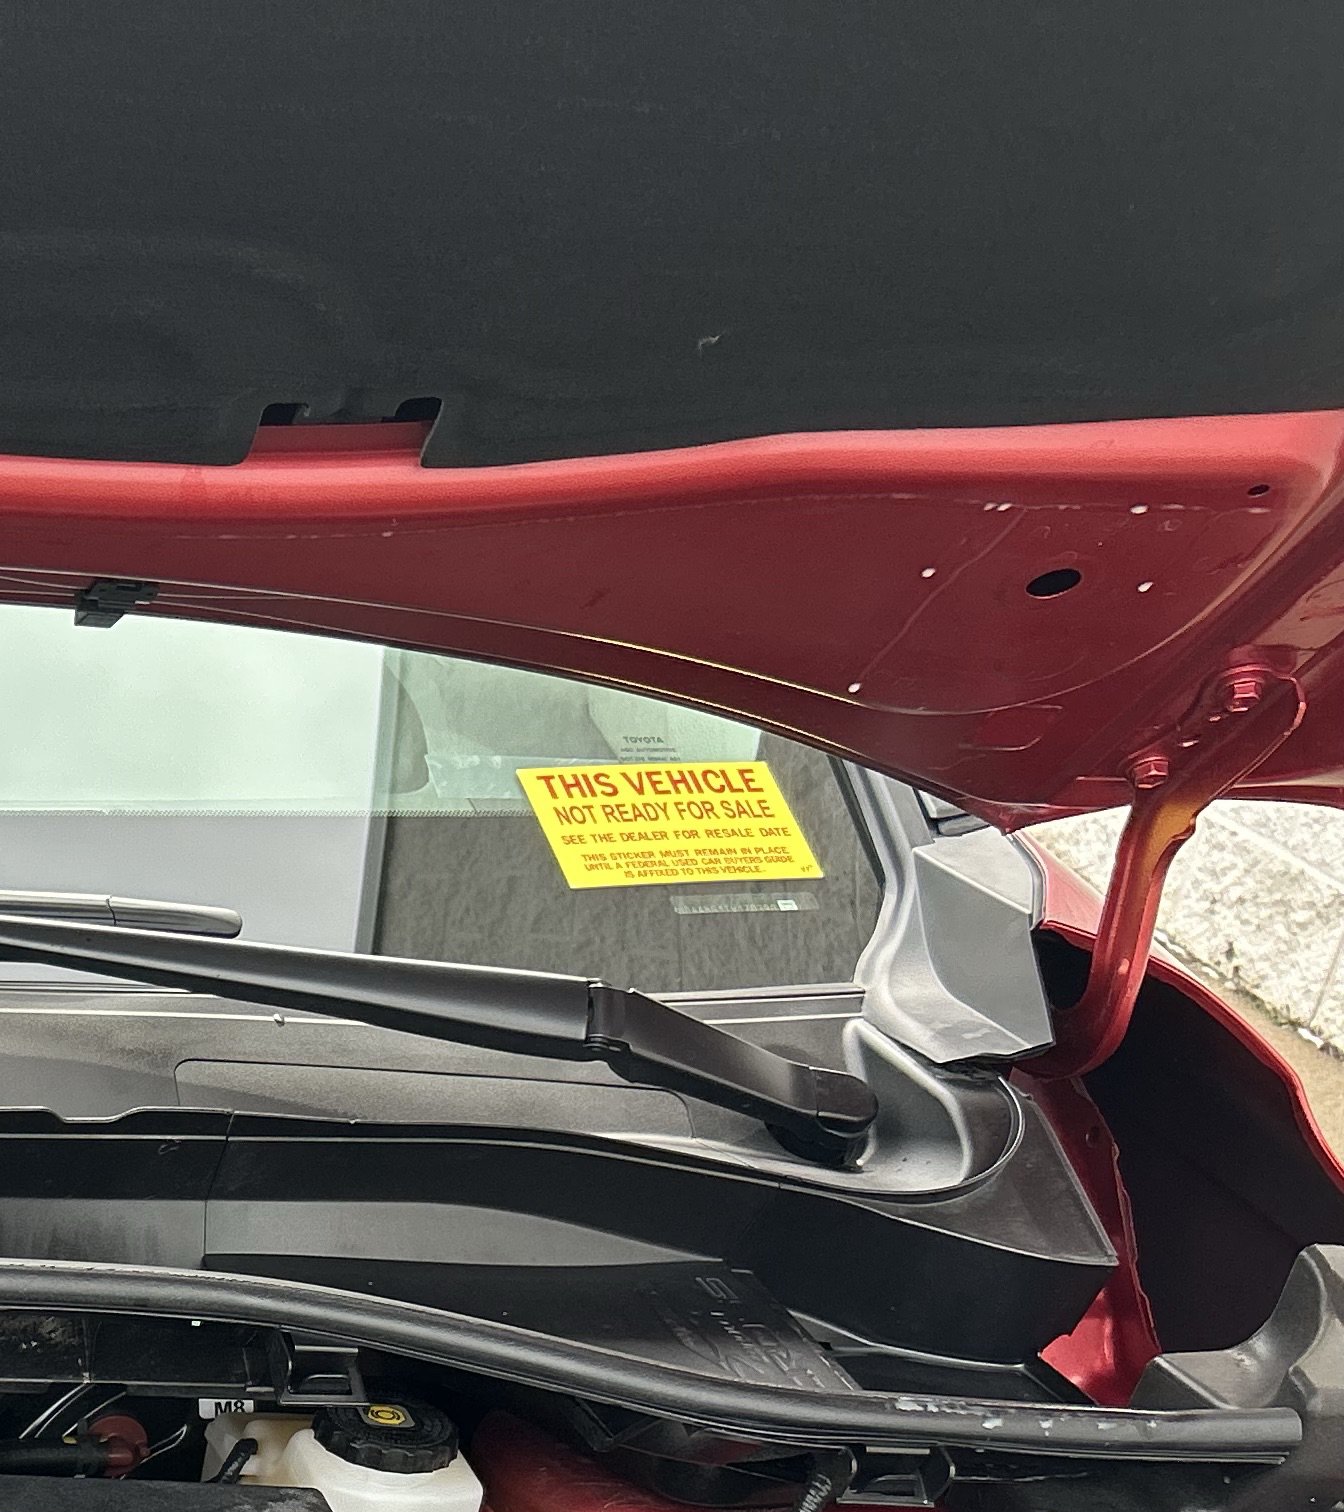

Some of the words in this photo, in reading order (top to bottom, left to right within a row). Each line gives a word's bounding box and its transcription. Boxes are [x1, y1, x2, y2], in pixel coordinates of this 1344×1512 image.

[536, 772, 619, 799] THIS
[619, 769, 764, 795] VEHICLE
[553, 805, 598, 825] NOT
[600, 802, 670, 823] READY
[673, 801, 720, 820] FOR
[720, 799, 775, 819] SALE
[561, 834, 587, 845] SEE
[590, 832, 617, 844] THE
[619, 830, 669, 841] DEALER
[673, 829, 700, 840] FOR
[704, 827, 755, 839] RESALE
[759, 827, 791, 837] DATE
[581, 853, 607, 862] THIS
[609, 850, 656, 861] STICKER
[659, 849, 689, 858] MUST
[694, 847, 737, 857] REMAIN
[740, 846, 752, 855] IN
[754, 846, 790, 855] PLACE
